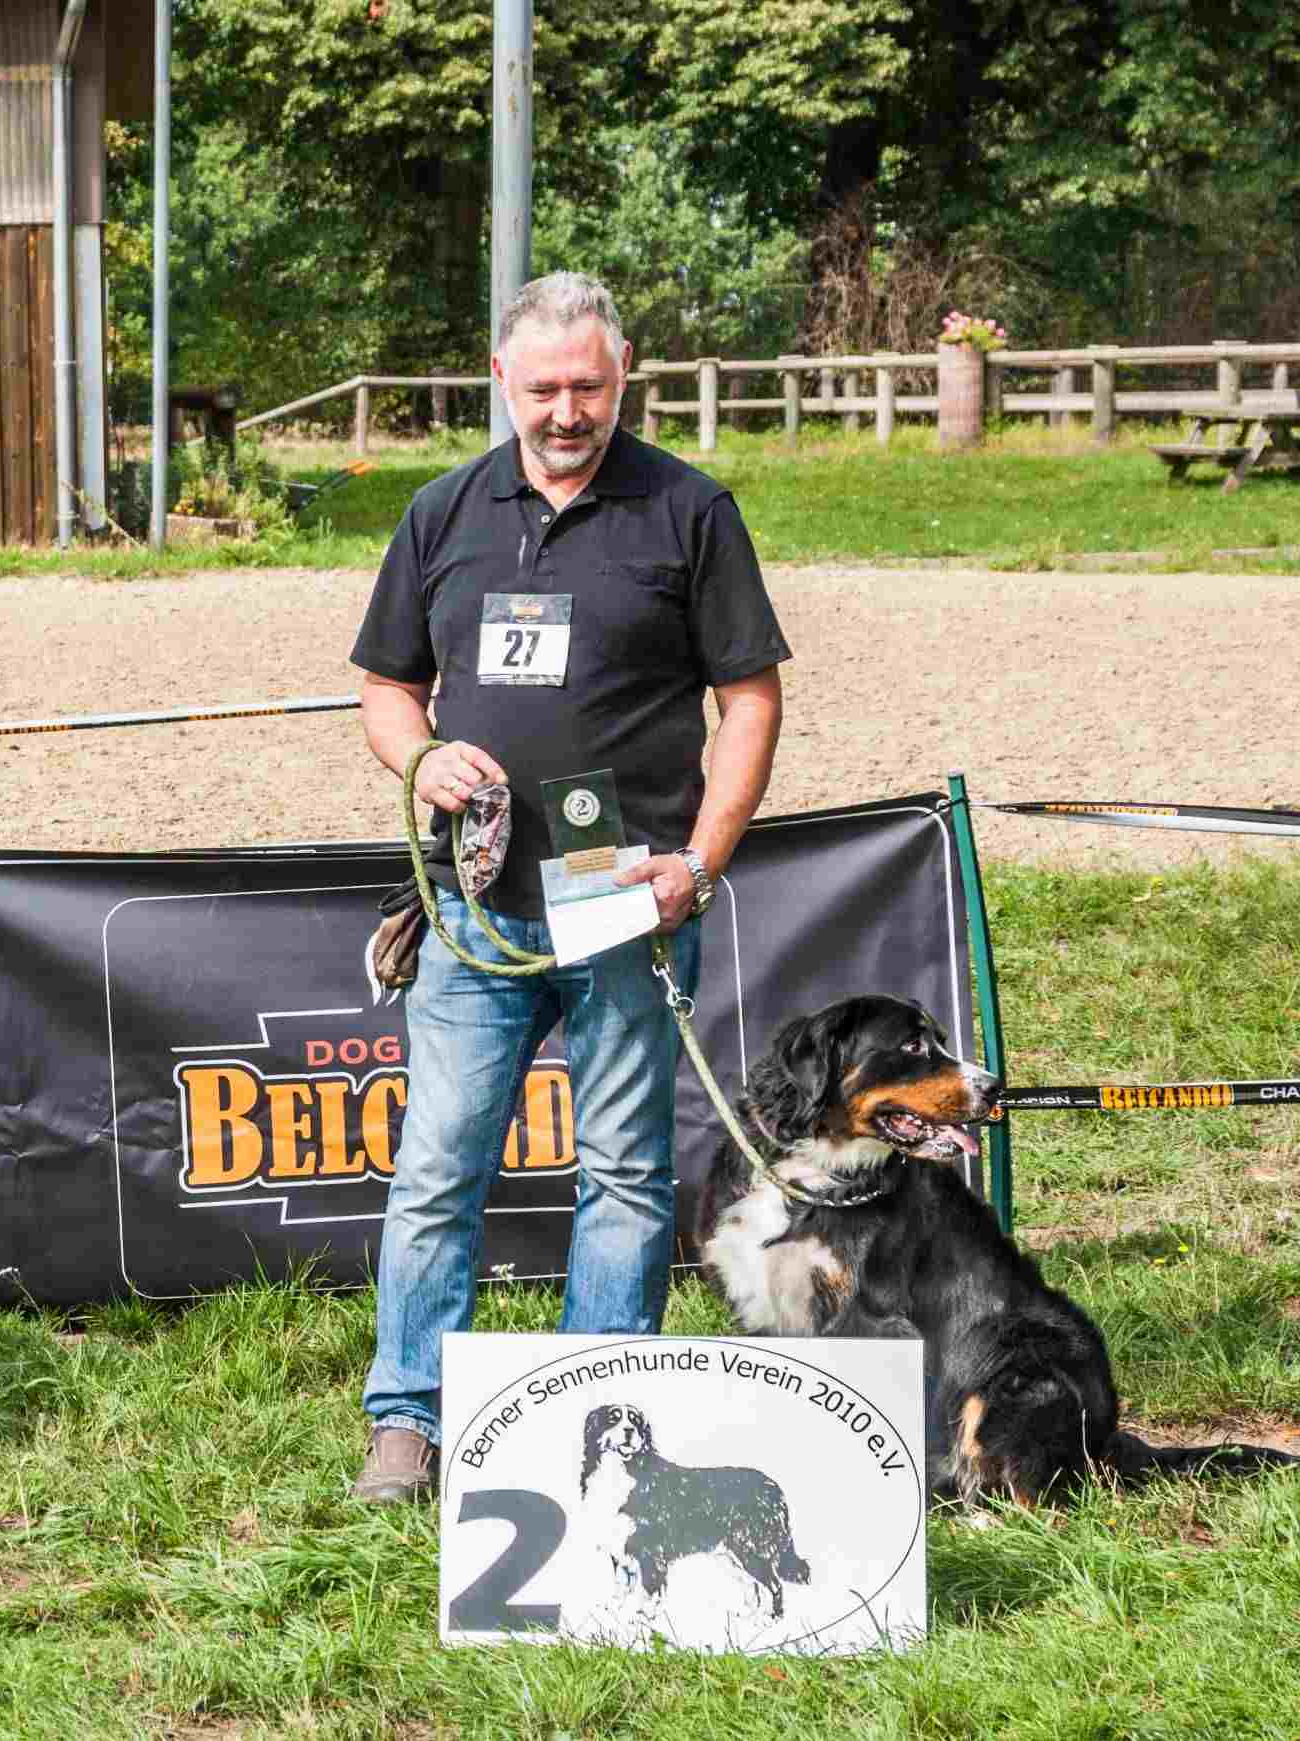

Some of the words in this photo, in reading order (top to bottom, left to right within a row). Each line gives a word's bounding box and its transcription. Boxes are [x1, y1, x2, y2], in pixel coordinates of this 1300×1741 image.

[502, 629, 541, 667] 27
[305, 1035, 402, 1067] DOG
[181, 1066, 576, 1186] BELCD
[460, 1396, 525, 1469] Berner
[527, 1347, 709, 1406] Sennenhunde
[720, 1350, 804, 1394] Verein
[808, 1381, 873, 1434] 2010
[866, 1433, 906, 1478] e.V.
[448, 1489, 567, 1633] 2
